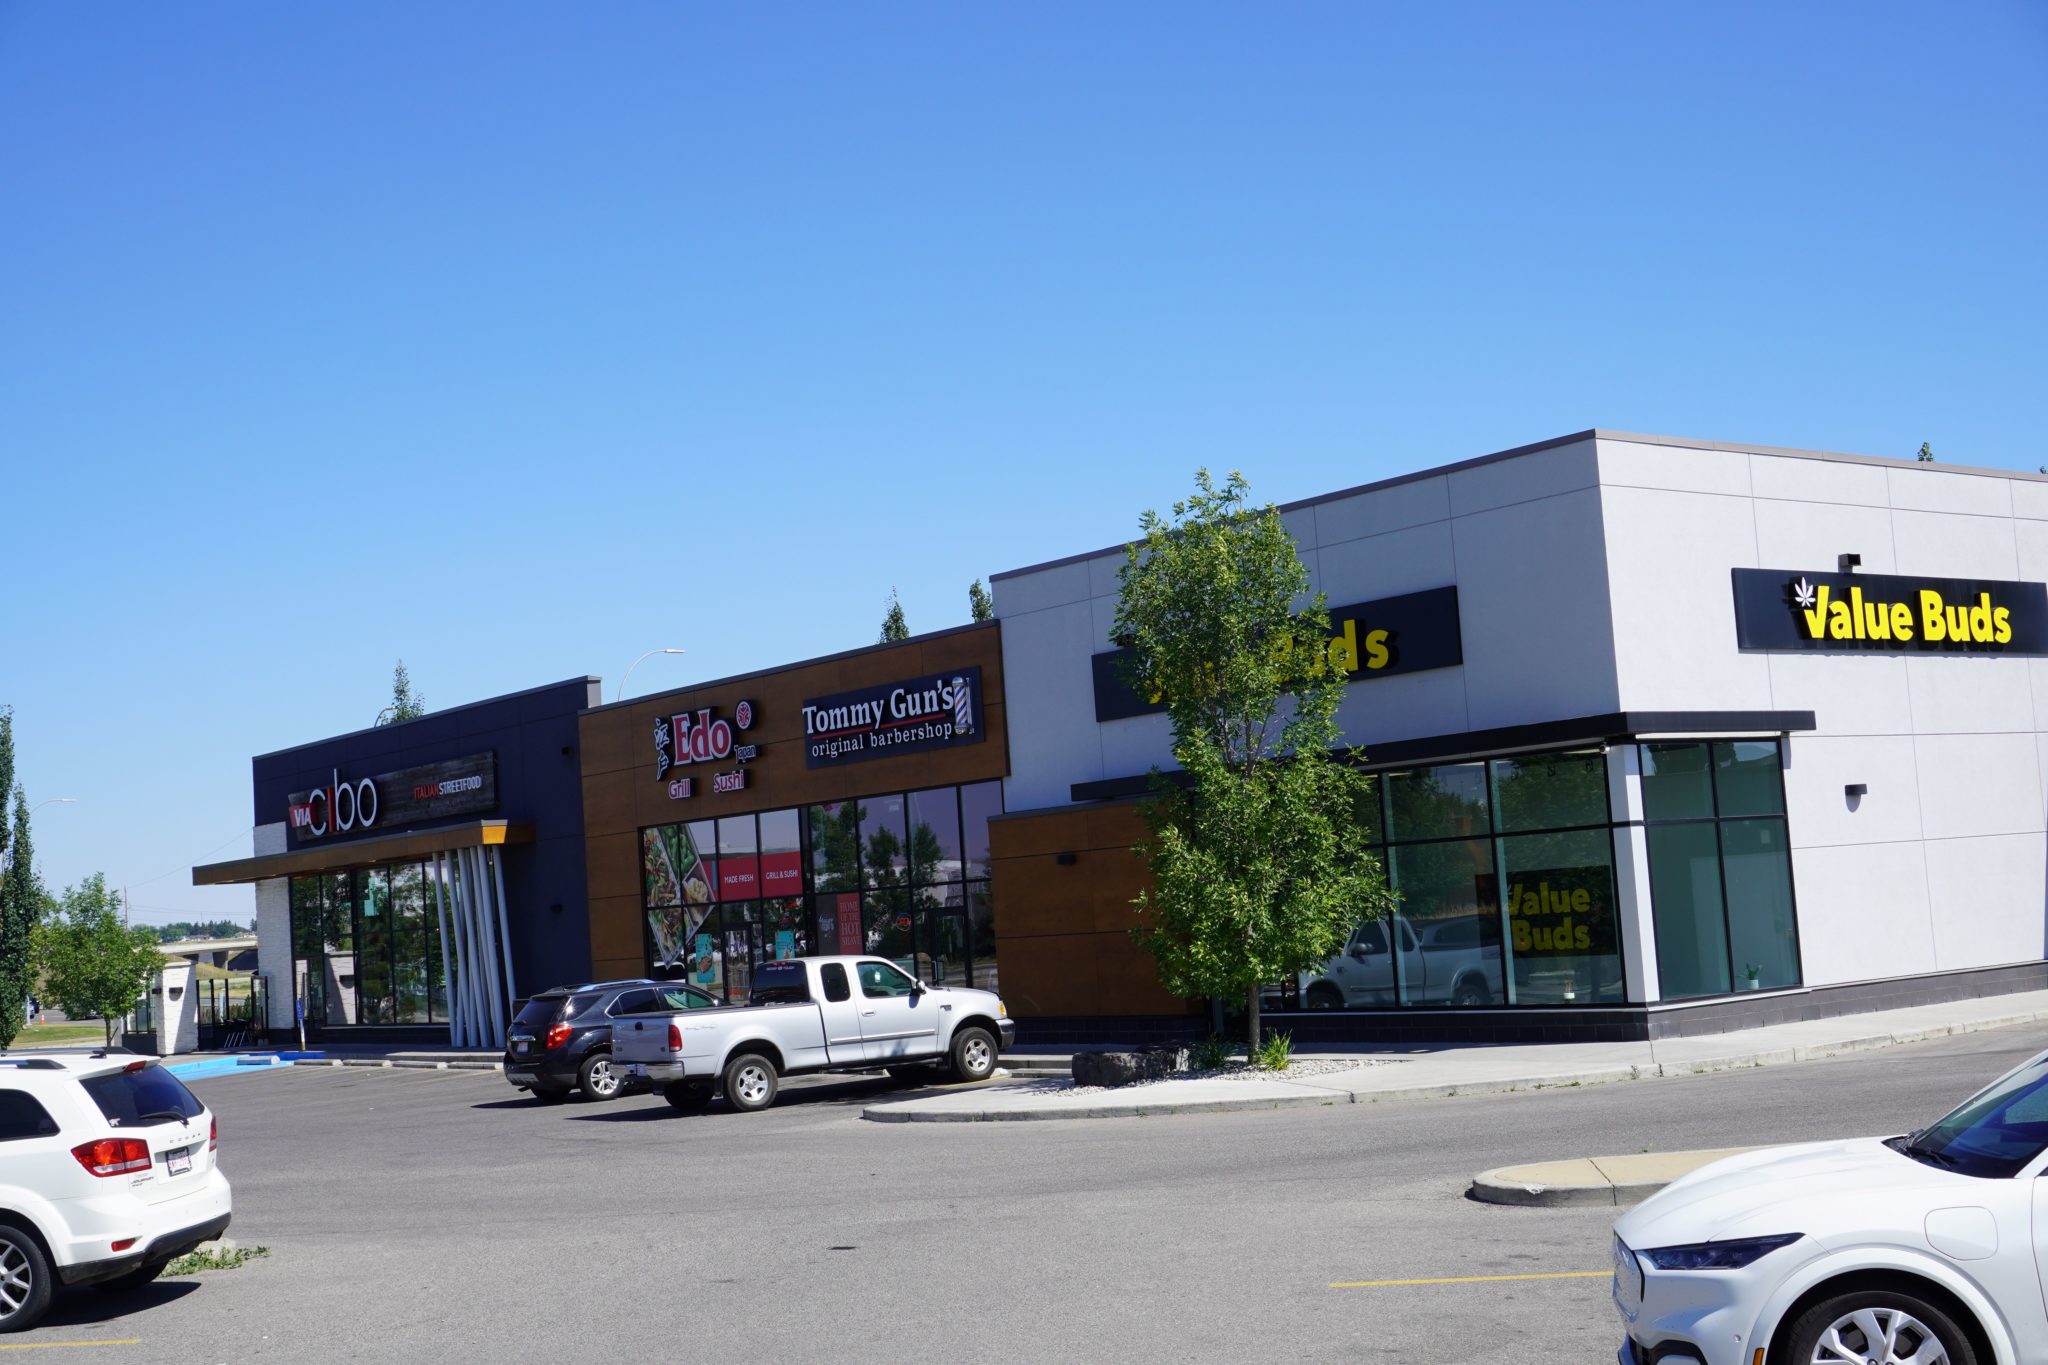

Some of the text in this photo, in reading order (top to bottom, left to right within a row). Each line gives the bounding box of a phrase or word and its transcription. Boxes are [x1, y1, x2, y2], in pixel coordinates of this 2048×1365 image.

[1804, 585, 2012, 643] Value Buds
[802, 680, 954, 734] Tommy Gun's
[672, 708, 731, 766] Edo
[812, 723, 952, 758] original barbershop
[734, 745, 757, 764] Japan
[668, 769, 745, 800] Grill Sushi
[294, 807, 311, 827] VIA
[724, 874, 754, 884] MADE FRESH
[765, 871, 780, 880] GRILL
[784, 869, 799, 878] SUSHI
[840, 901, 859, 913] HOME
[1508, 882, 1590, 915] Value
[841, 922, 860, 935] HOT
[1511, 917, 1591, 951] Buds
